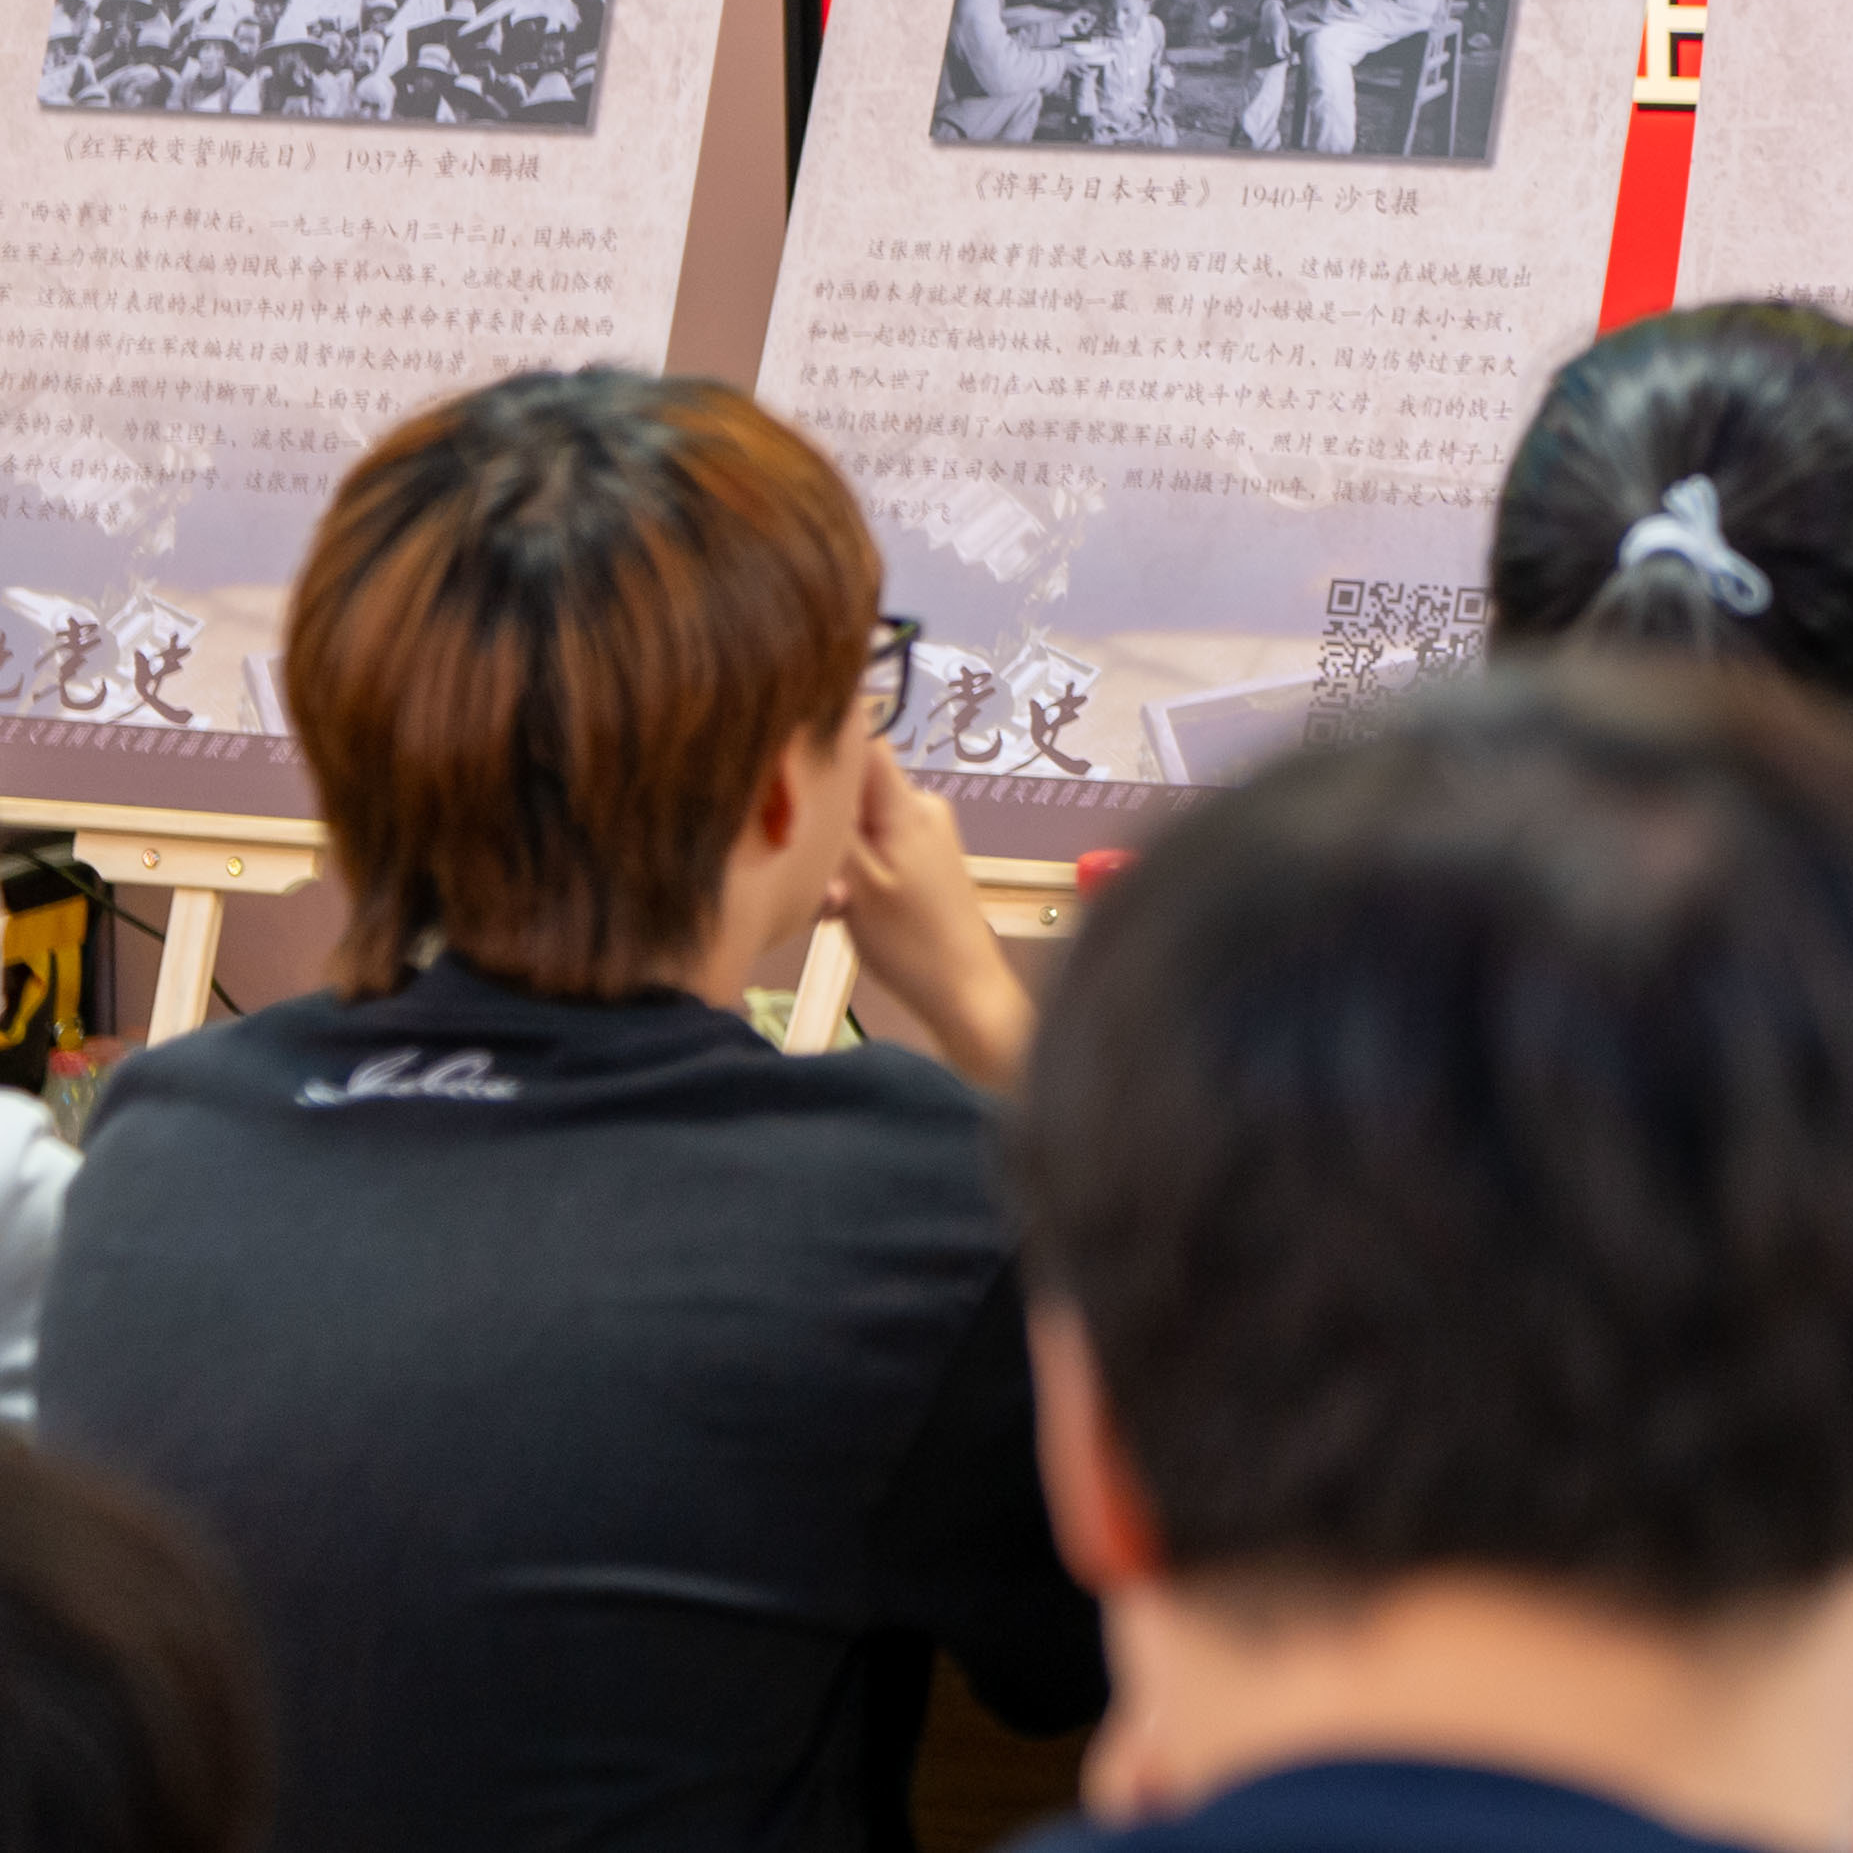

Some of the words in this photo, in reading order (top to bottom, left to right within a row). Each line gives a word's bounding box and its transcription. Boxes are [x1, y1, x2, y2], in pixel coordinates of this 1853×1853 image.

[1241, 183, 1323, 213] 1940年
[1334, 185, 1419, 217] 沙飞摄
[0, 616, 193, 725] 党史
[895, 666, 1092, 775] 党史
